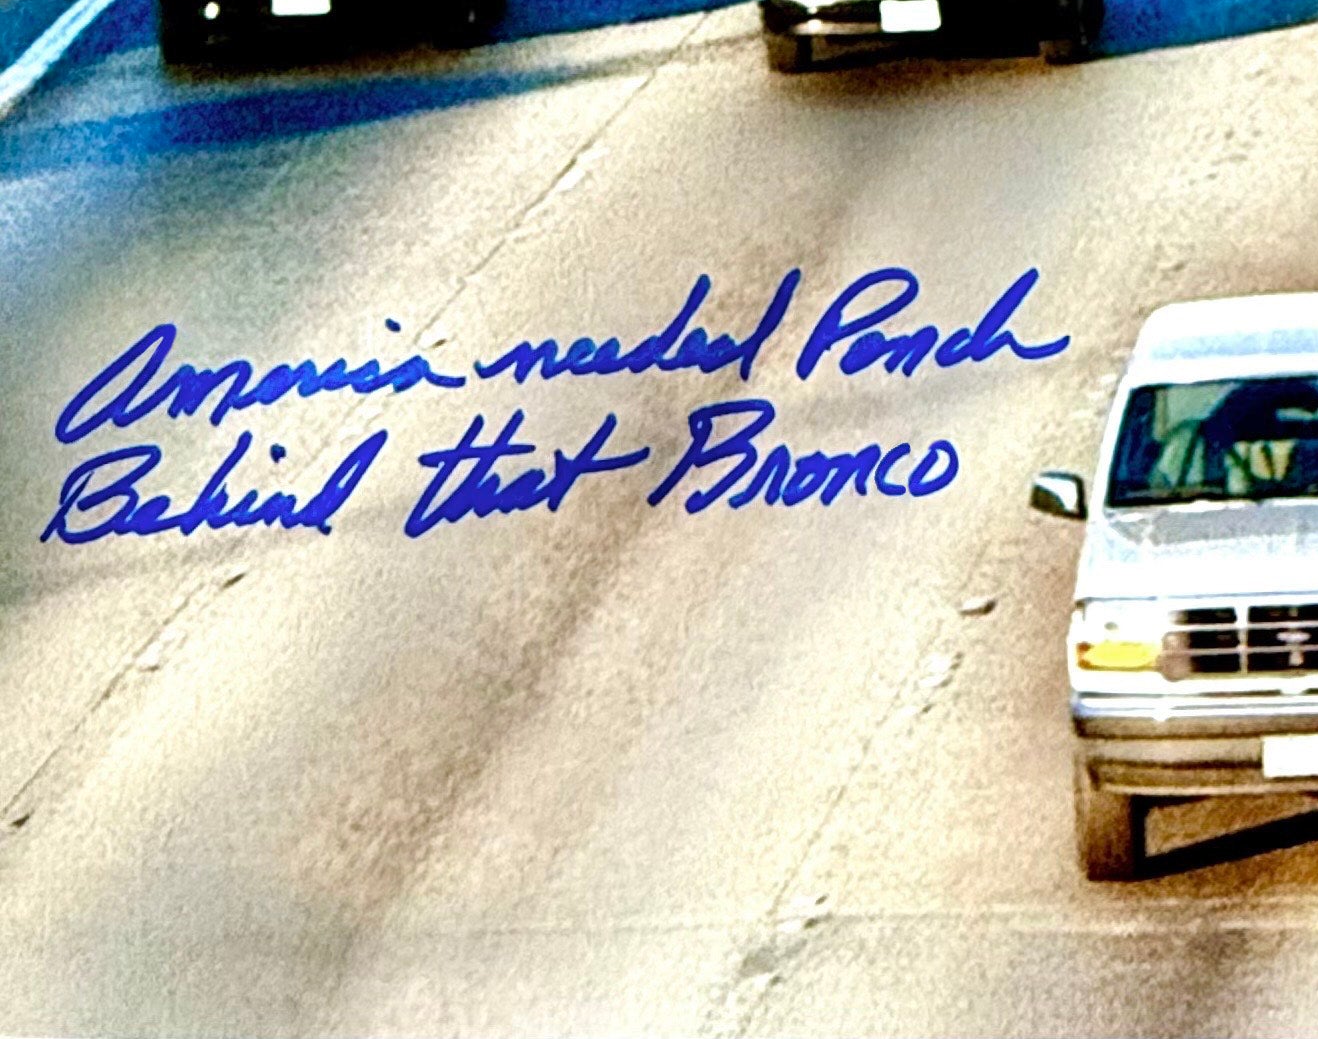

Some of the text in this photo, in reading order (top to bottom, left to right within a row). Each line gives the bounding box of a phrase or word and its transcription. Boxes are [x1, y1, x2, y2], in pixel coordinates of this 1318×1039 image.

[475, 269, 800, 384] needed
[41, 399, 960, 544] Behind that Bronco
